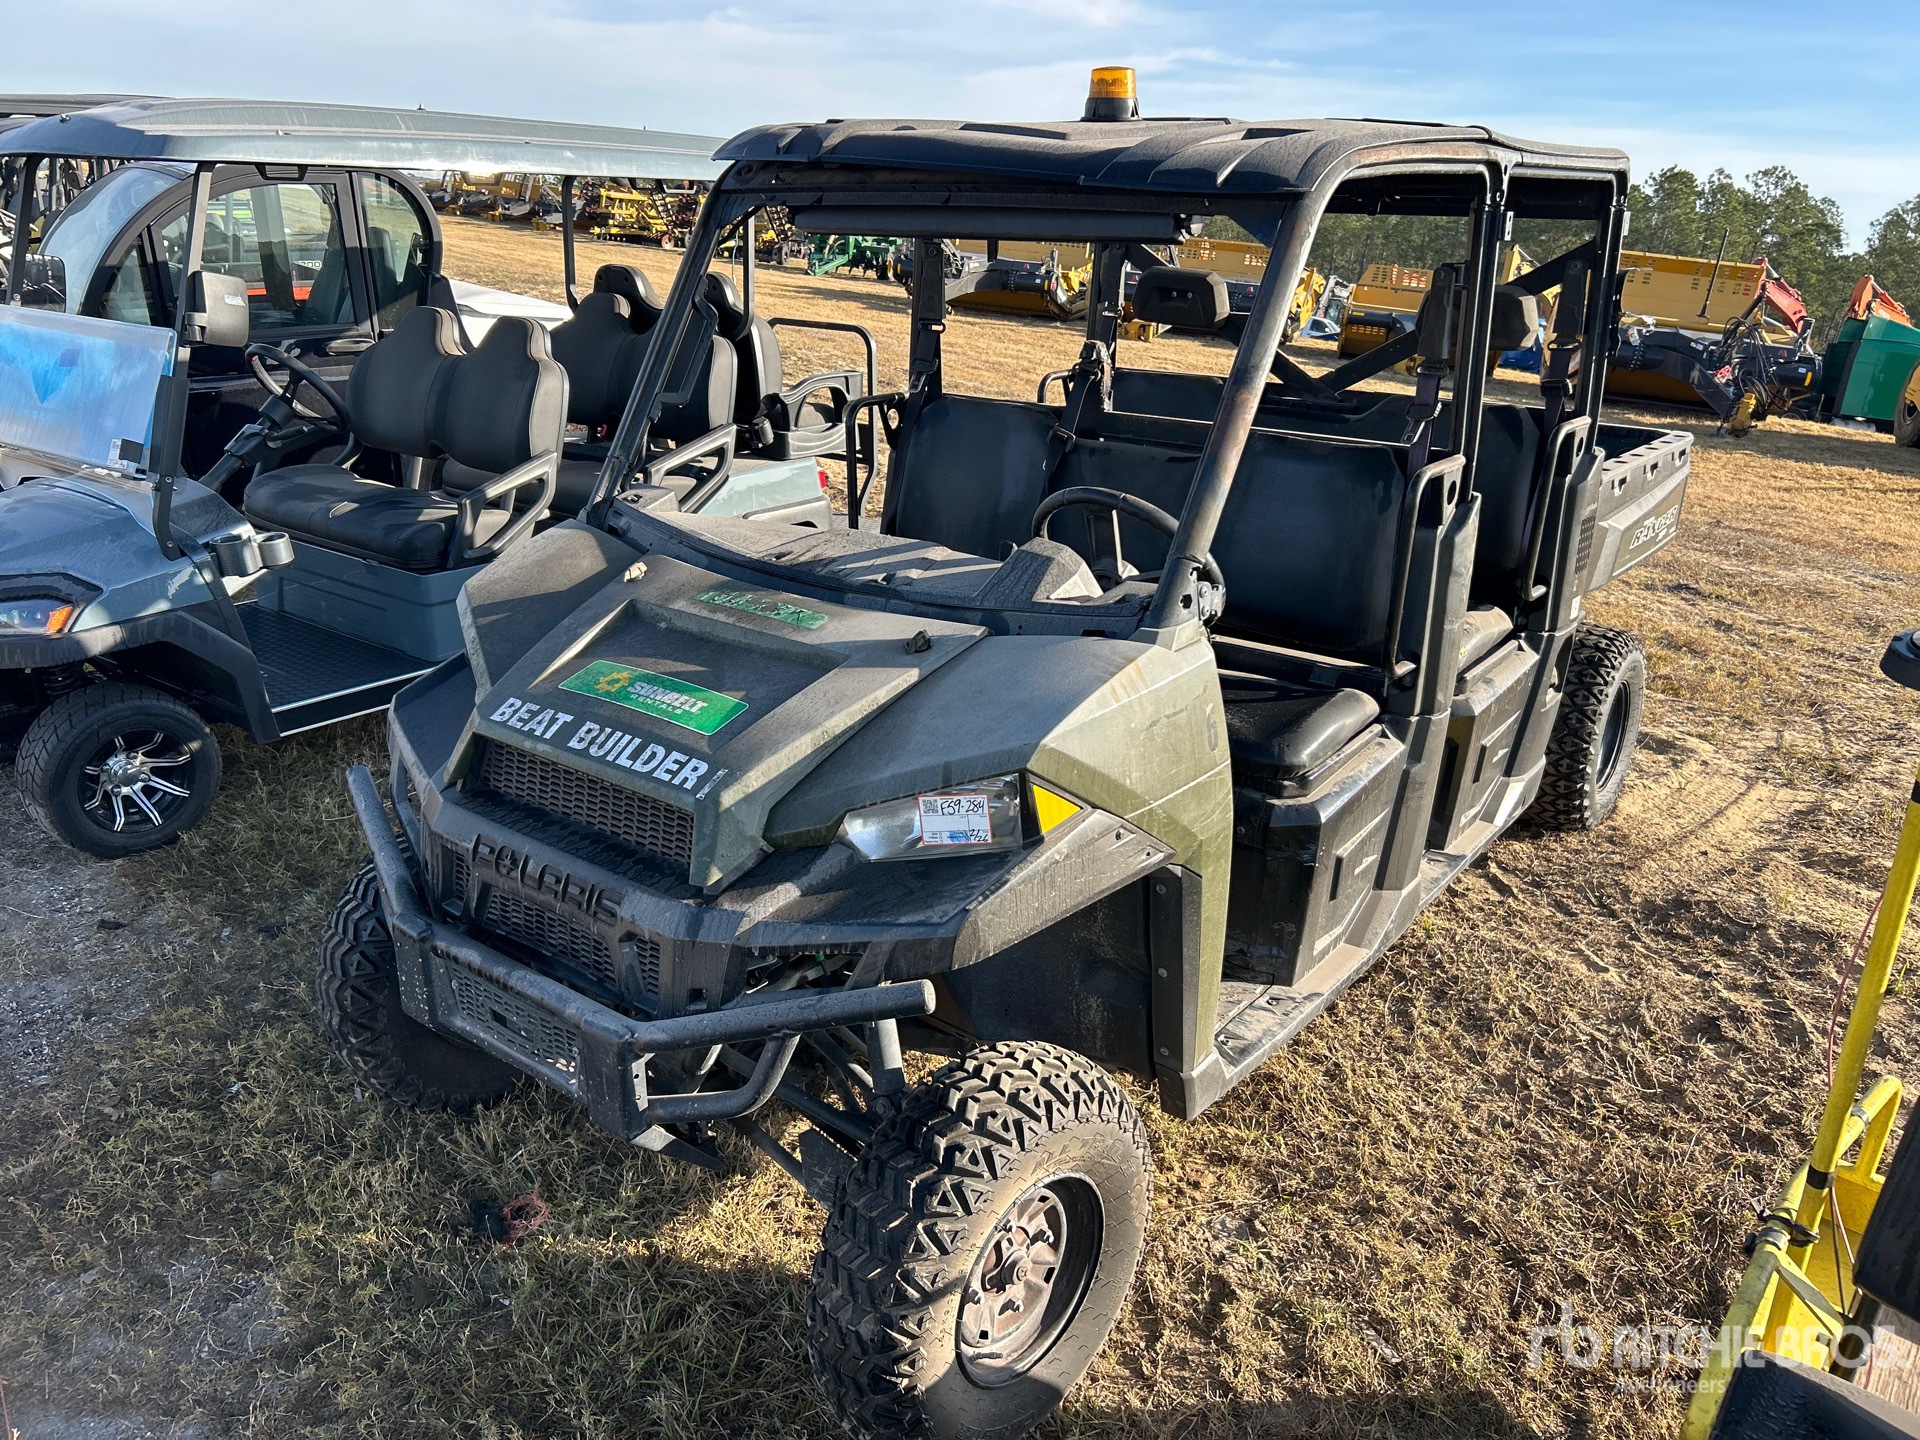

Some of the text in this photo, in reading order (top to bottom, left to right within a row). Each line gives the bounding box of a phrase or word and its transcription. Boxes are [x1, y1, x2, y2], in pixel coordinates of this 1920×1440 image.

[627, 681, 708, 713] SUNBELT
[630, 694, 683, 714] RENTALS
[490, 697, 709, 789] BEAT BUILDER
[940, 798, 985, 815] F59-284
[472, 833, 625, 927] POLARIS
